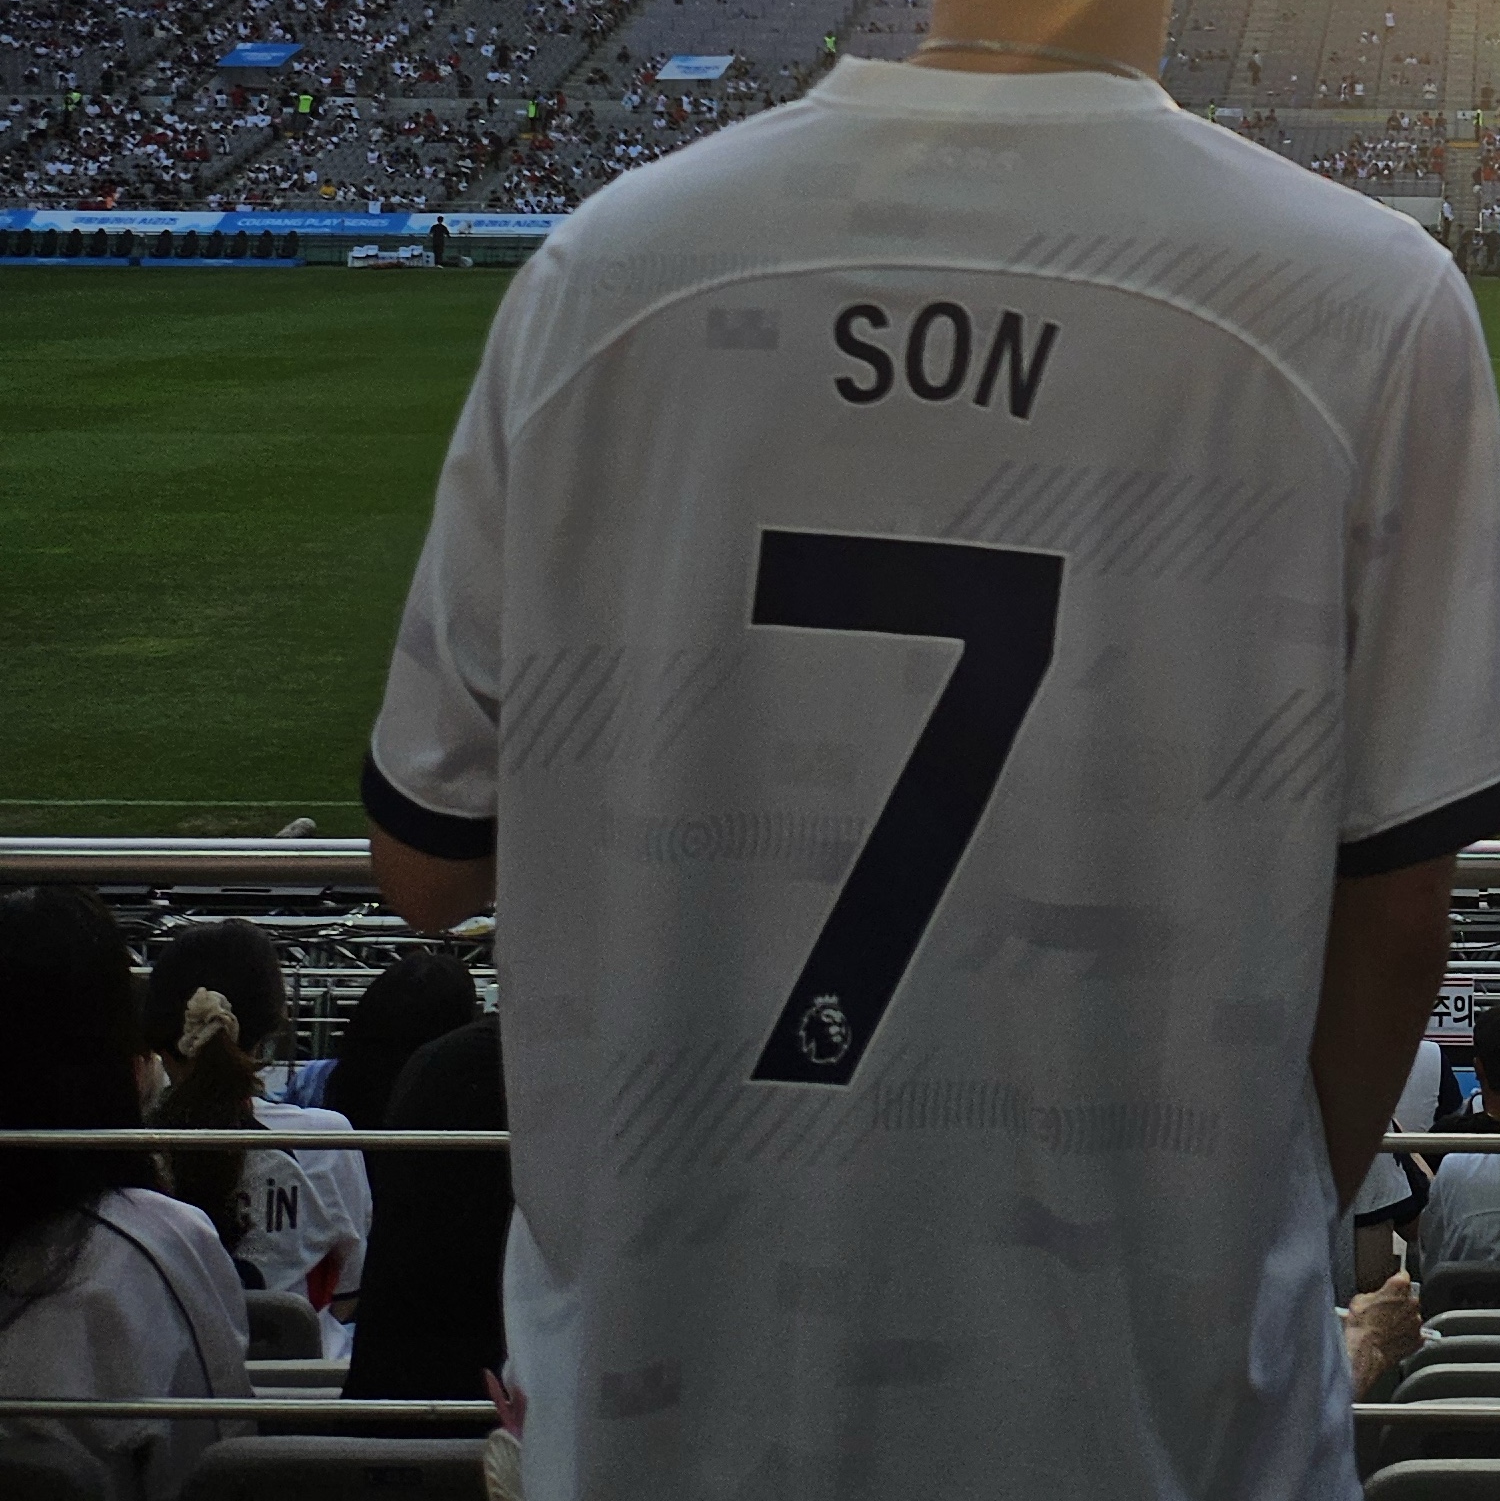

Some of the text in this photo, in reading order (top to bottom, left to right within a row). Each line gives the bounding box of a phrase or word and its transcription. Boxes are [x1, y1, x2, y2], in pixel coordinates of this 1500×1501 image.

[832, 302, 1060, 420] SON
[750, 529, 1066, 1085] 7
[1432, 994, 1473, 1028] 주의
